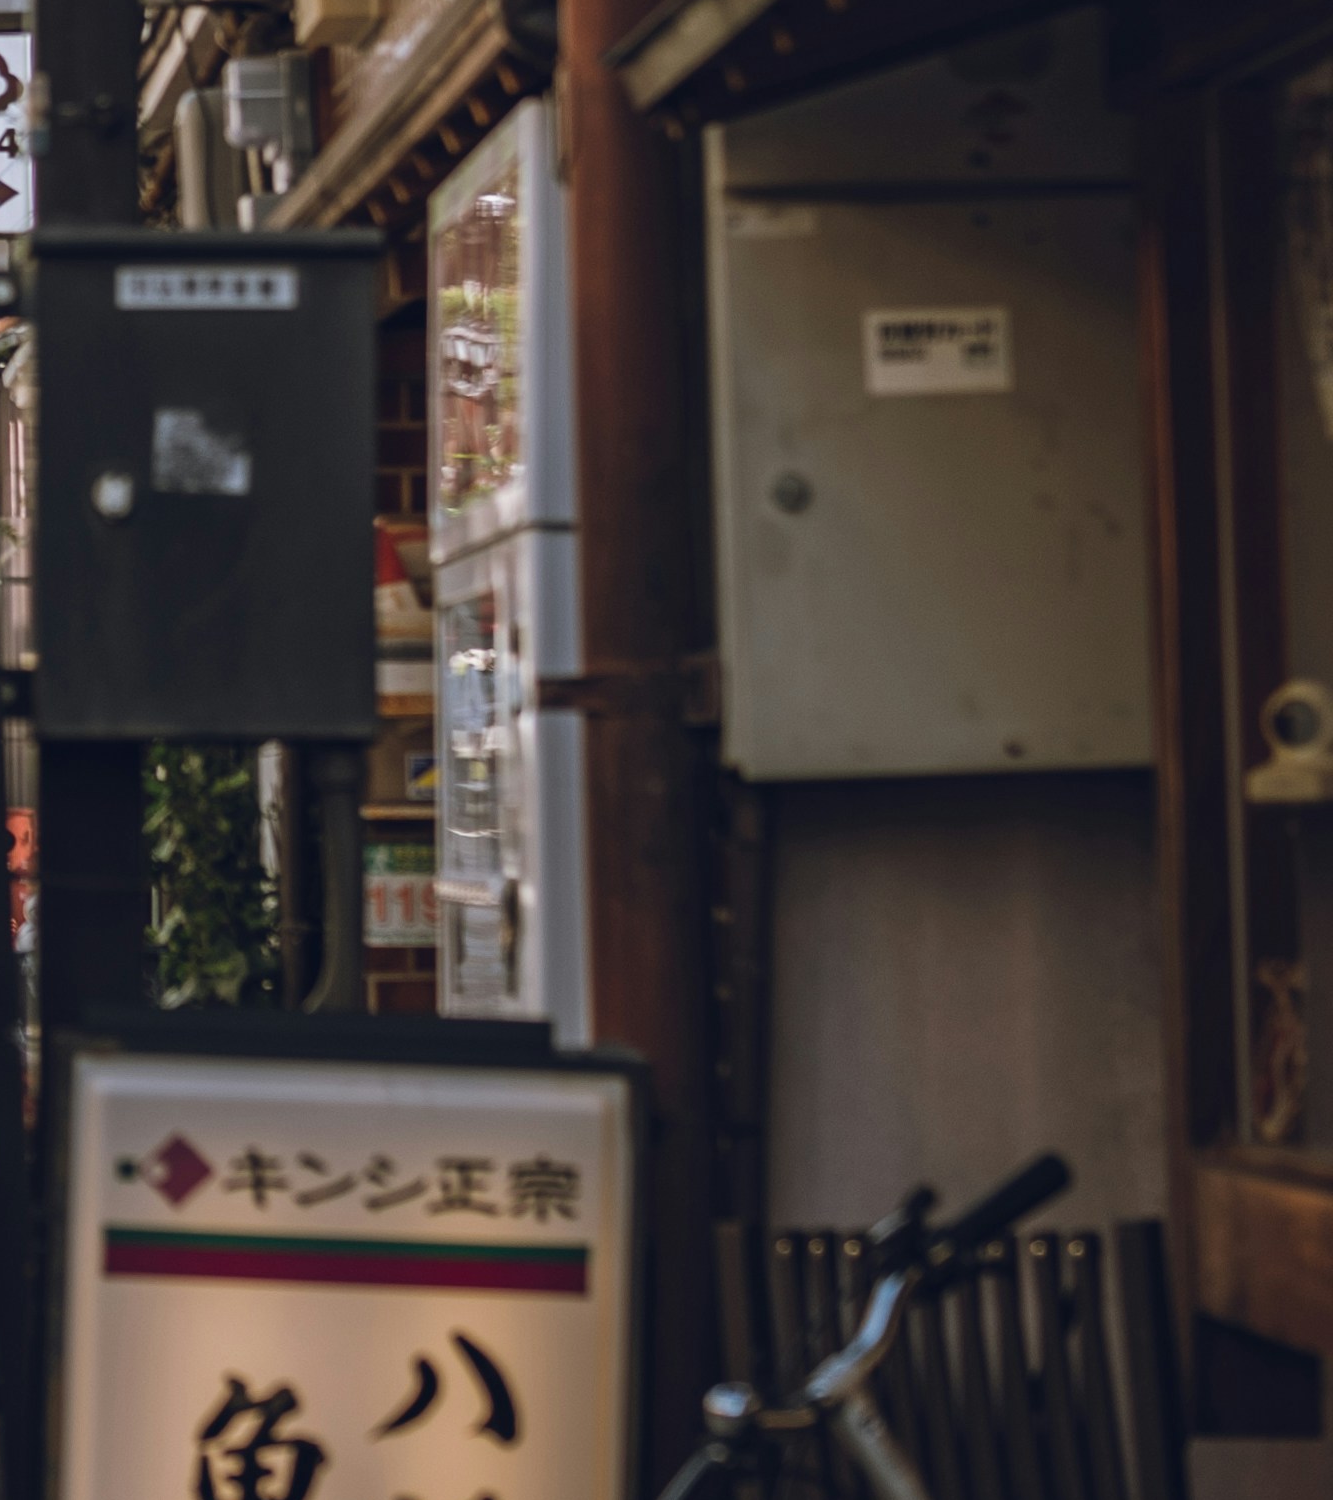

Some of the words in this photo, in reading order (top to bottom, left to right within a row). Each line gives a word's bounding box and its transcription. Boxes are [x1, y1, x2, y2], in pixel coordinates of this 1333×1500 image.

[221, 1145, 581, 1223] キンシ正宗
